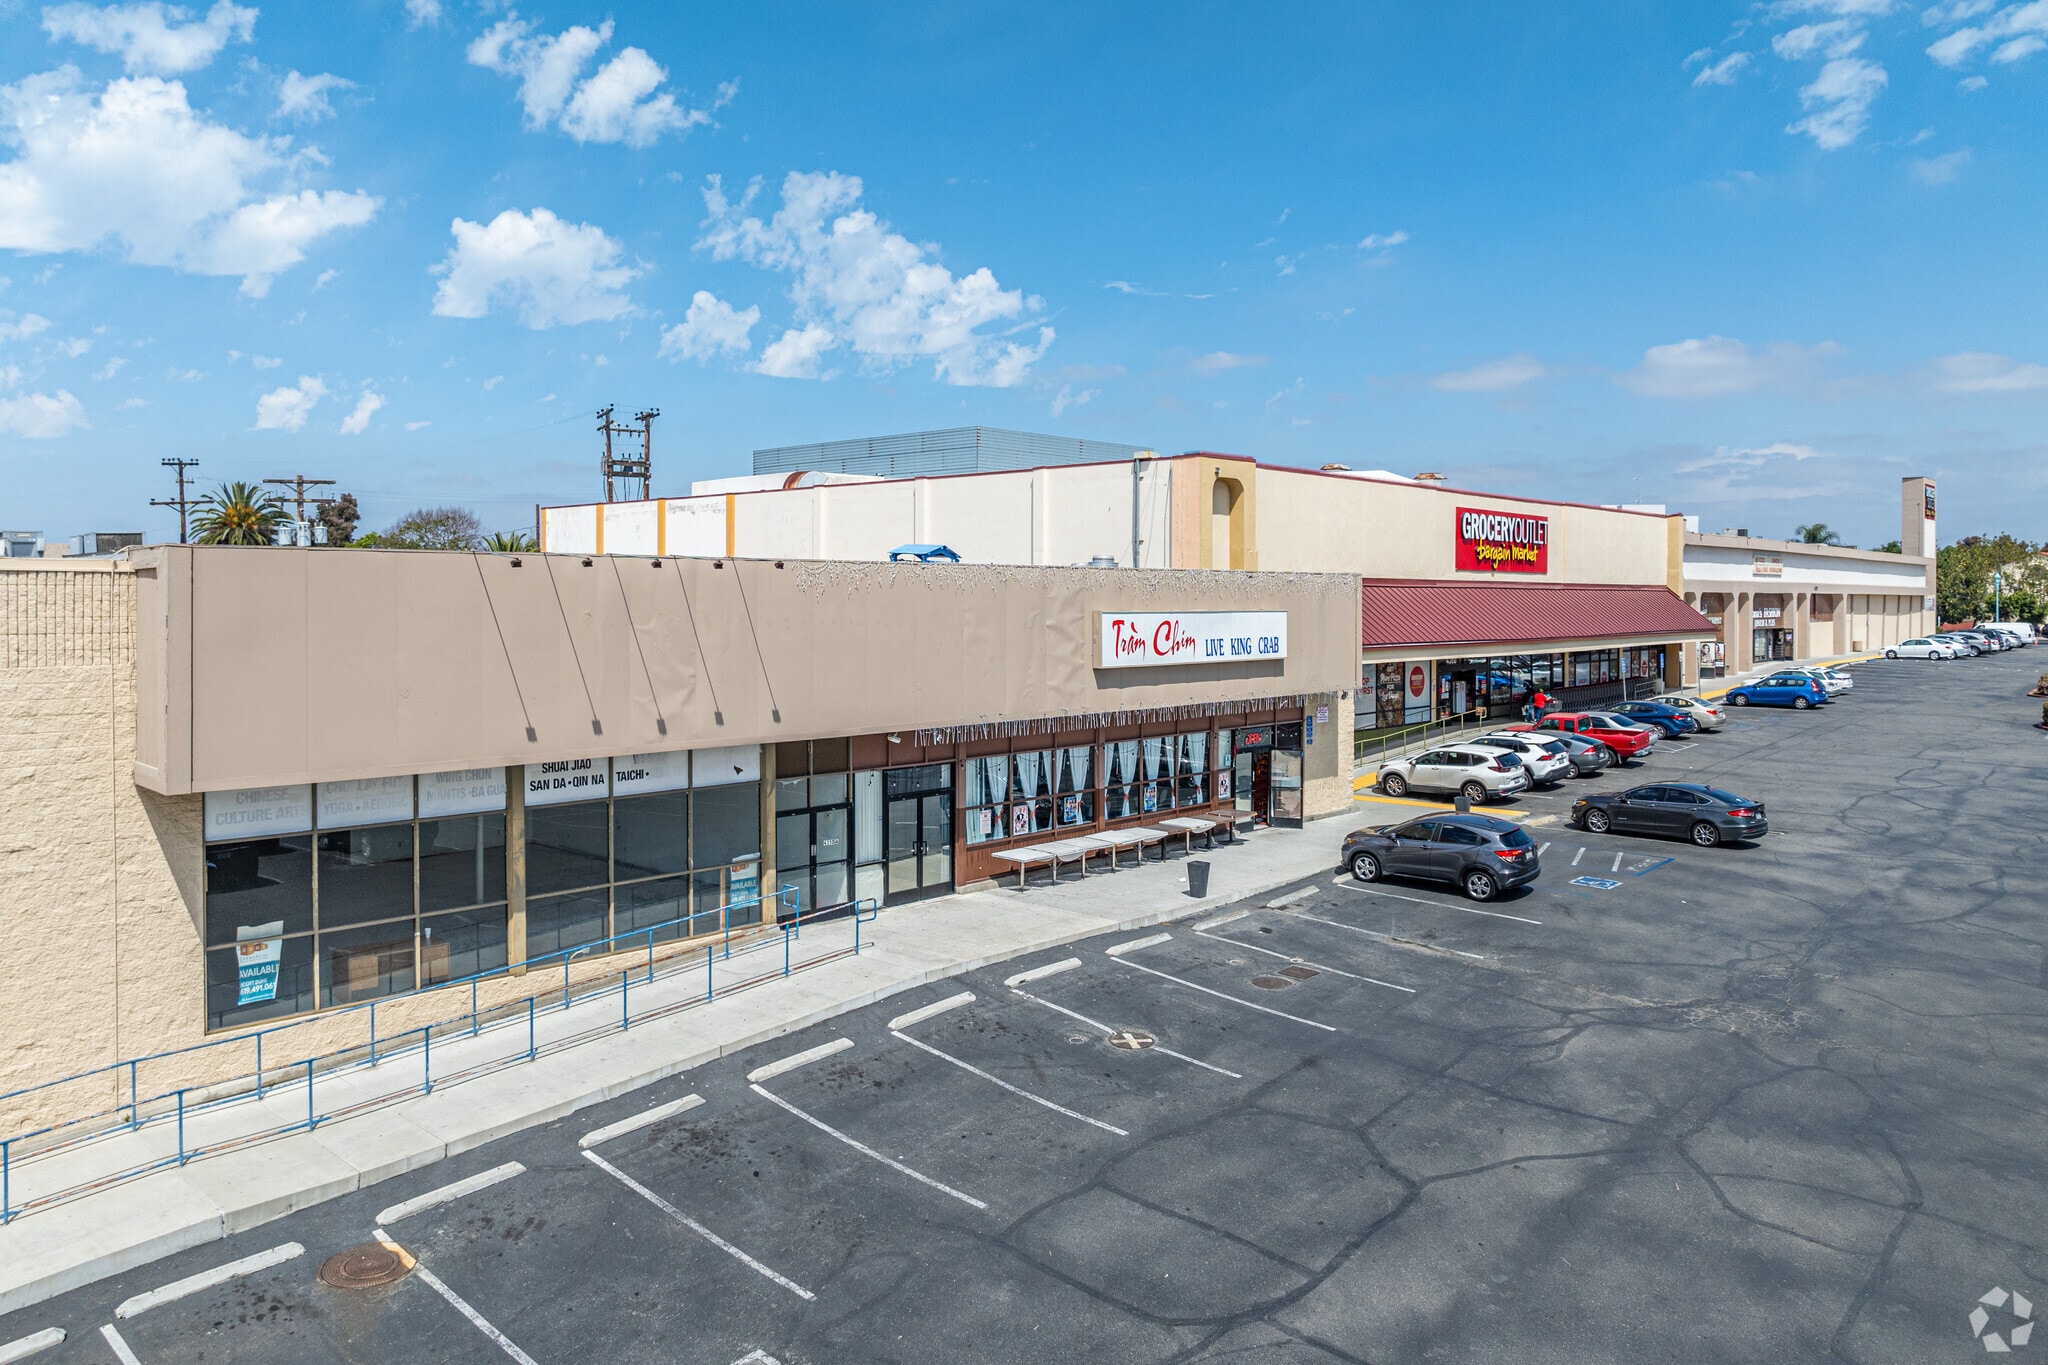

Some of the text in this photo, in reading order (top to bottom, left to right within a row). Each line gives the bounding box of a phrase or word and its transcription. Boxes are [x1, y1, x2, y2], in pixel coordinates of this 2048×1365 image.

[1477, 535, 1511, 569] bargain
[1152, 619, 1196, 659] Chim
[1205, 638, 1225, 657] LIVE
[1230, 637, 1252, 656] KING
[1258, 636, 1280, 654] CRAB
[541, 758, 592, 774] SHUAI JIAO
[435, 768, 492, 784] WING CHUN
[529, 779, 550, 792] SAN
[591, 774, 605, 785] NA
[616, 769, 645, 782] TAICHI
[235, 787, 289, 805] CHINESE
[215, 808, 272, 826] CULTURE
